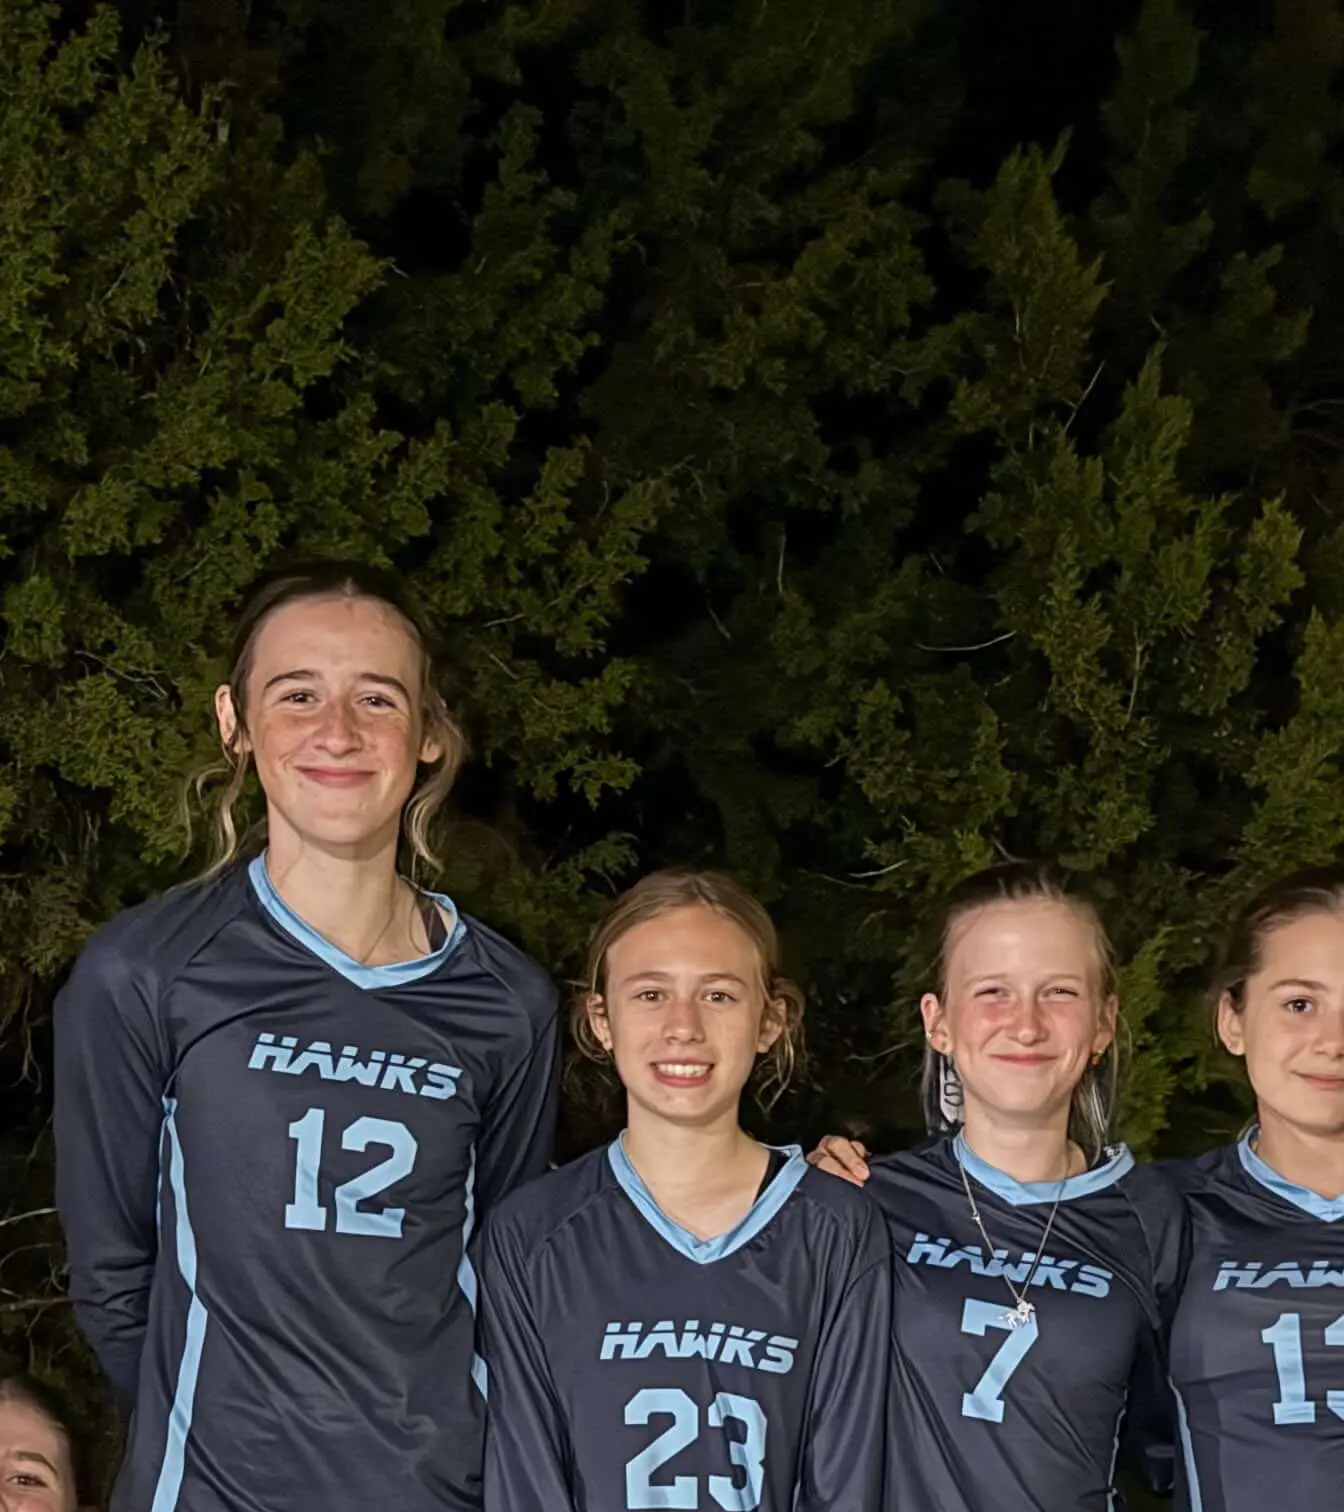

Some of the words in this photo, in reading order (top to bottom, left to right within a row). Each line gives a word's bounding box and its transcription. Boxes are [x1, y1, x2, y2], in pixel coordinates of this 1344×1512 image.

[248, 1032, 464, 1100] HAWKS
[285, 1107, 418, 1238] 12
[906, 1233, 1114, 1298] HAWKS
[599, 1319, 800, 1374] HAWKS
[960, 1297, 1039, 1424] 7
[624, 1388, 768, 1512] 23
